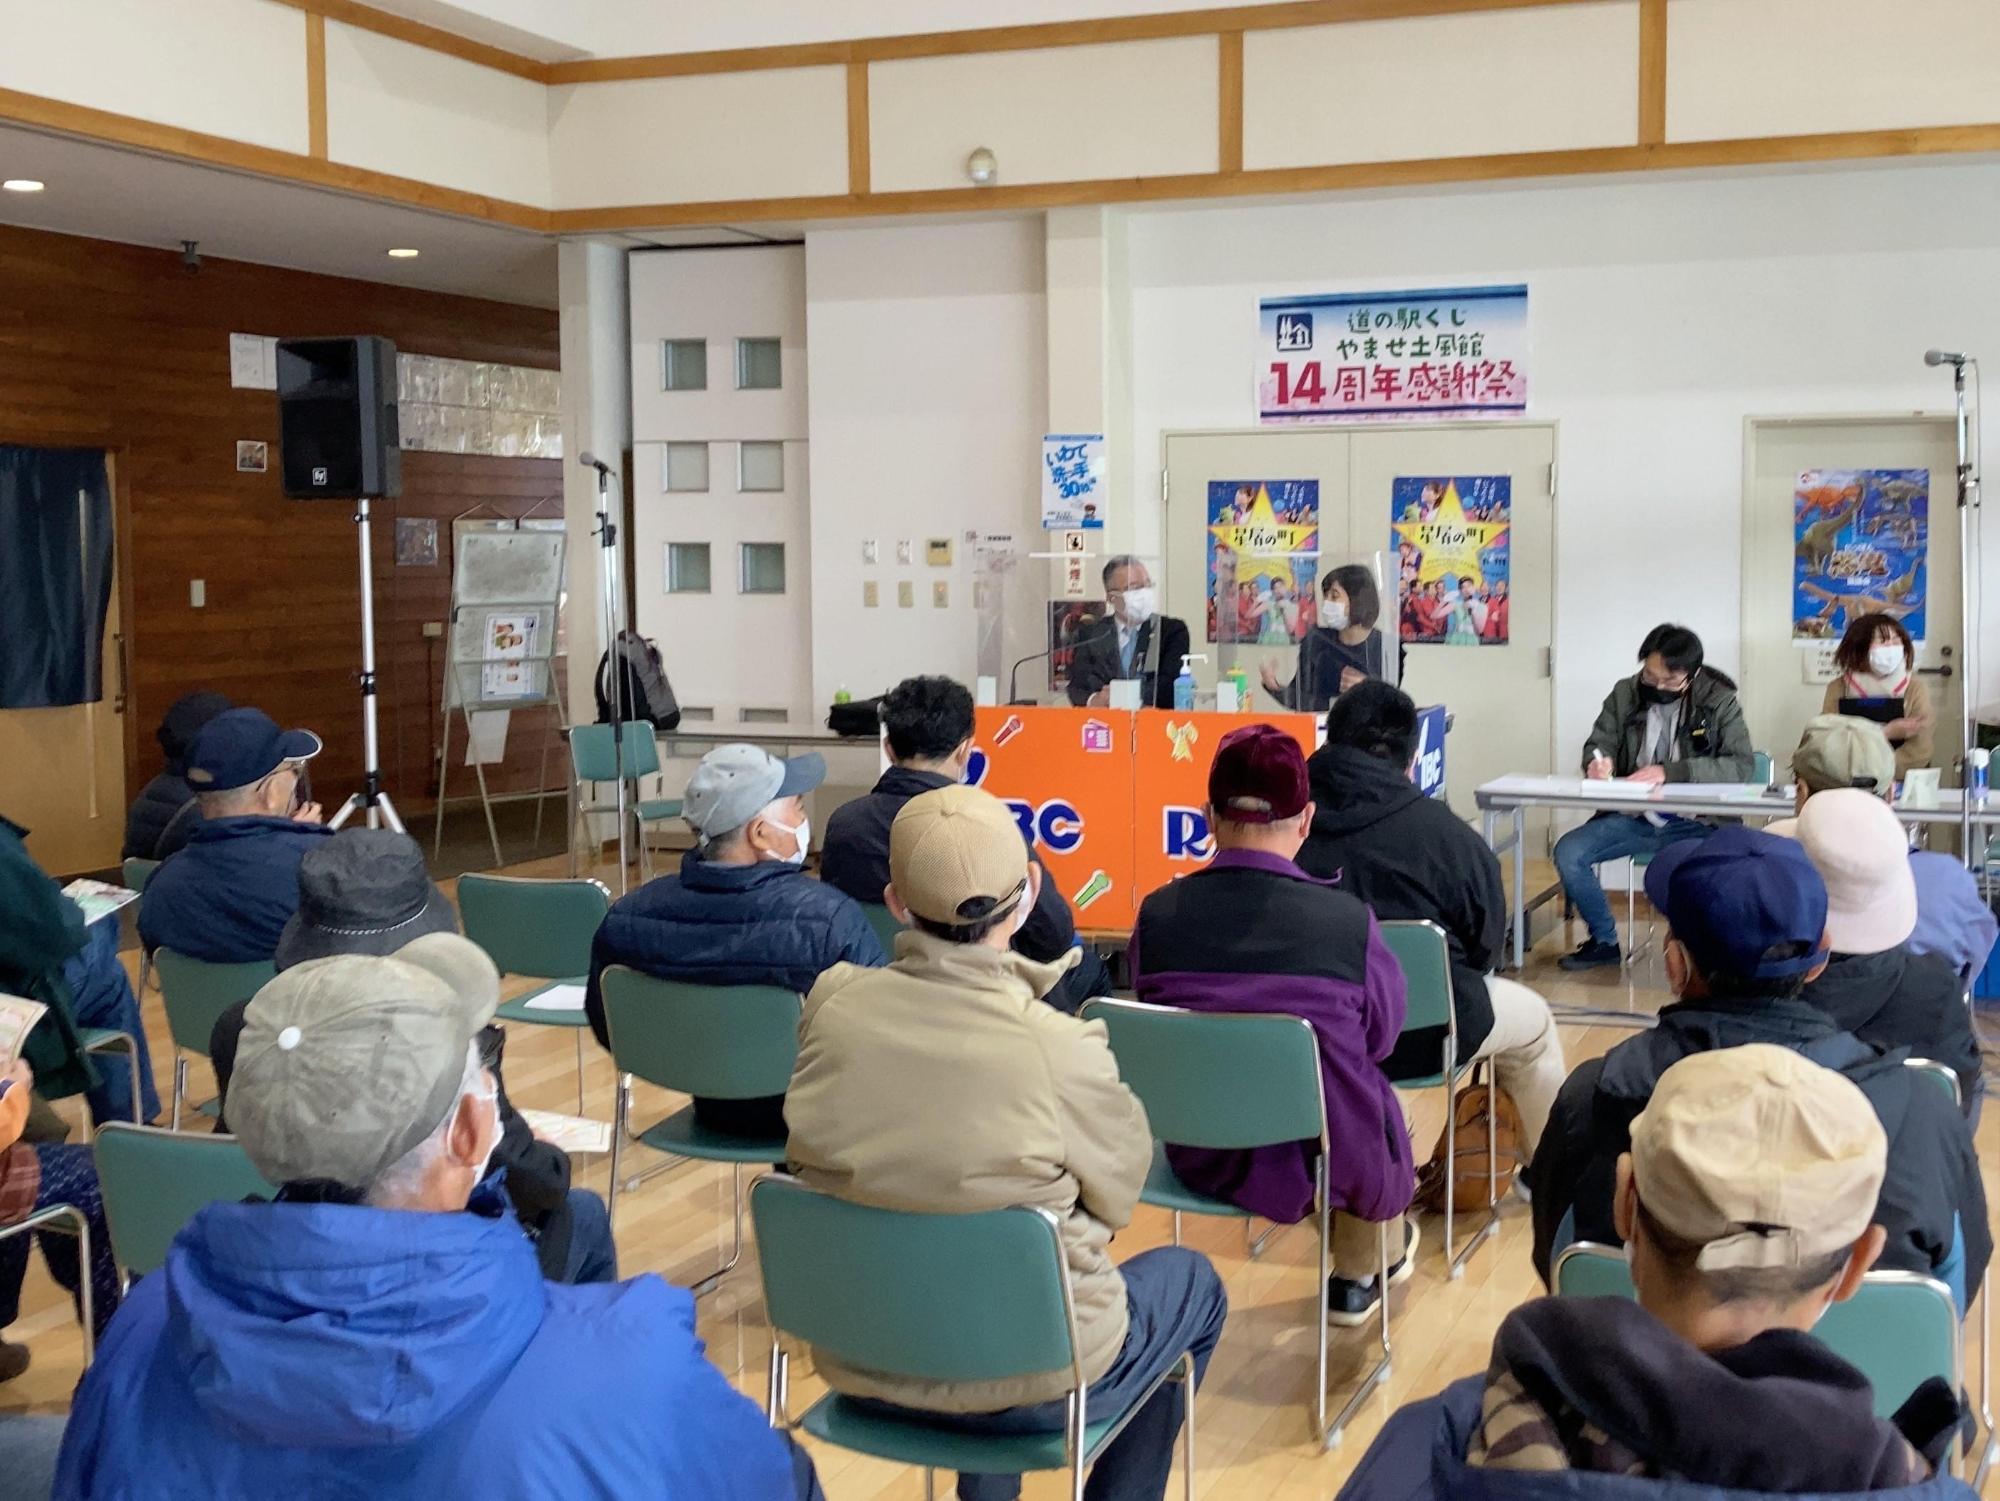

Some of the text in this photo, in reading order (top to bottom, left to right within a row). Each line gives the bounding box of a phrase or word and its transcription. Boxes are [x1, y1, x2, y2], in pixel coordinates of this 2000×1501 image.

[1347, 307, 1468, 333] 道の駅くじ
[1336, 333, 1485, 361] やませ土風館
[1270, 360, 1516, 405] 14周年感謝祭
